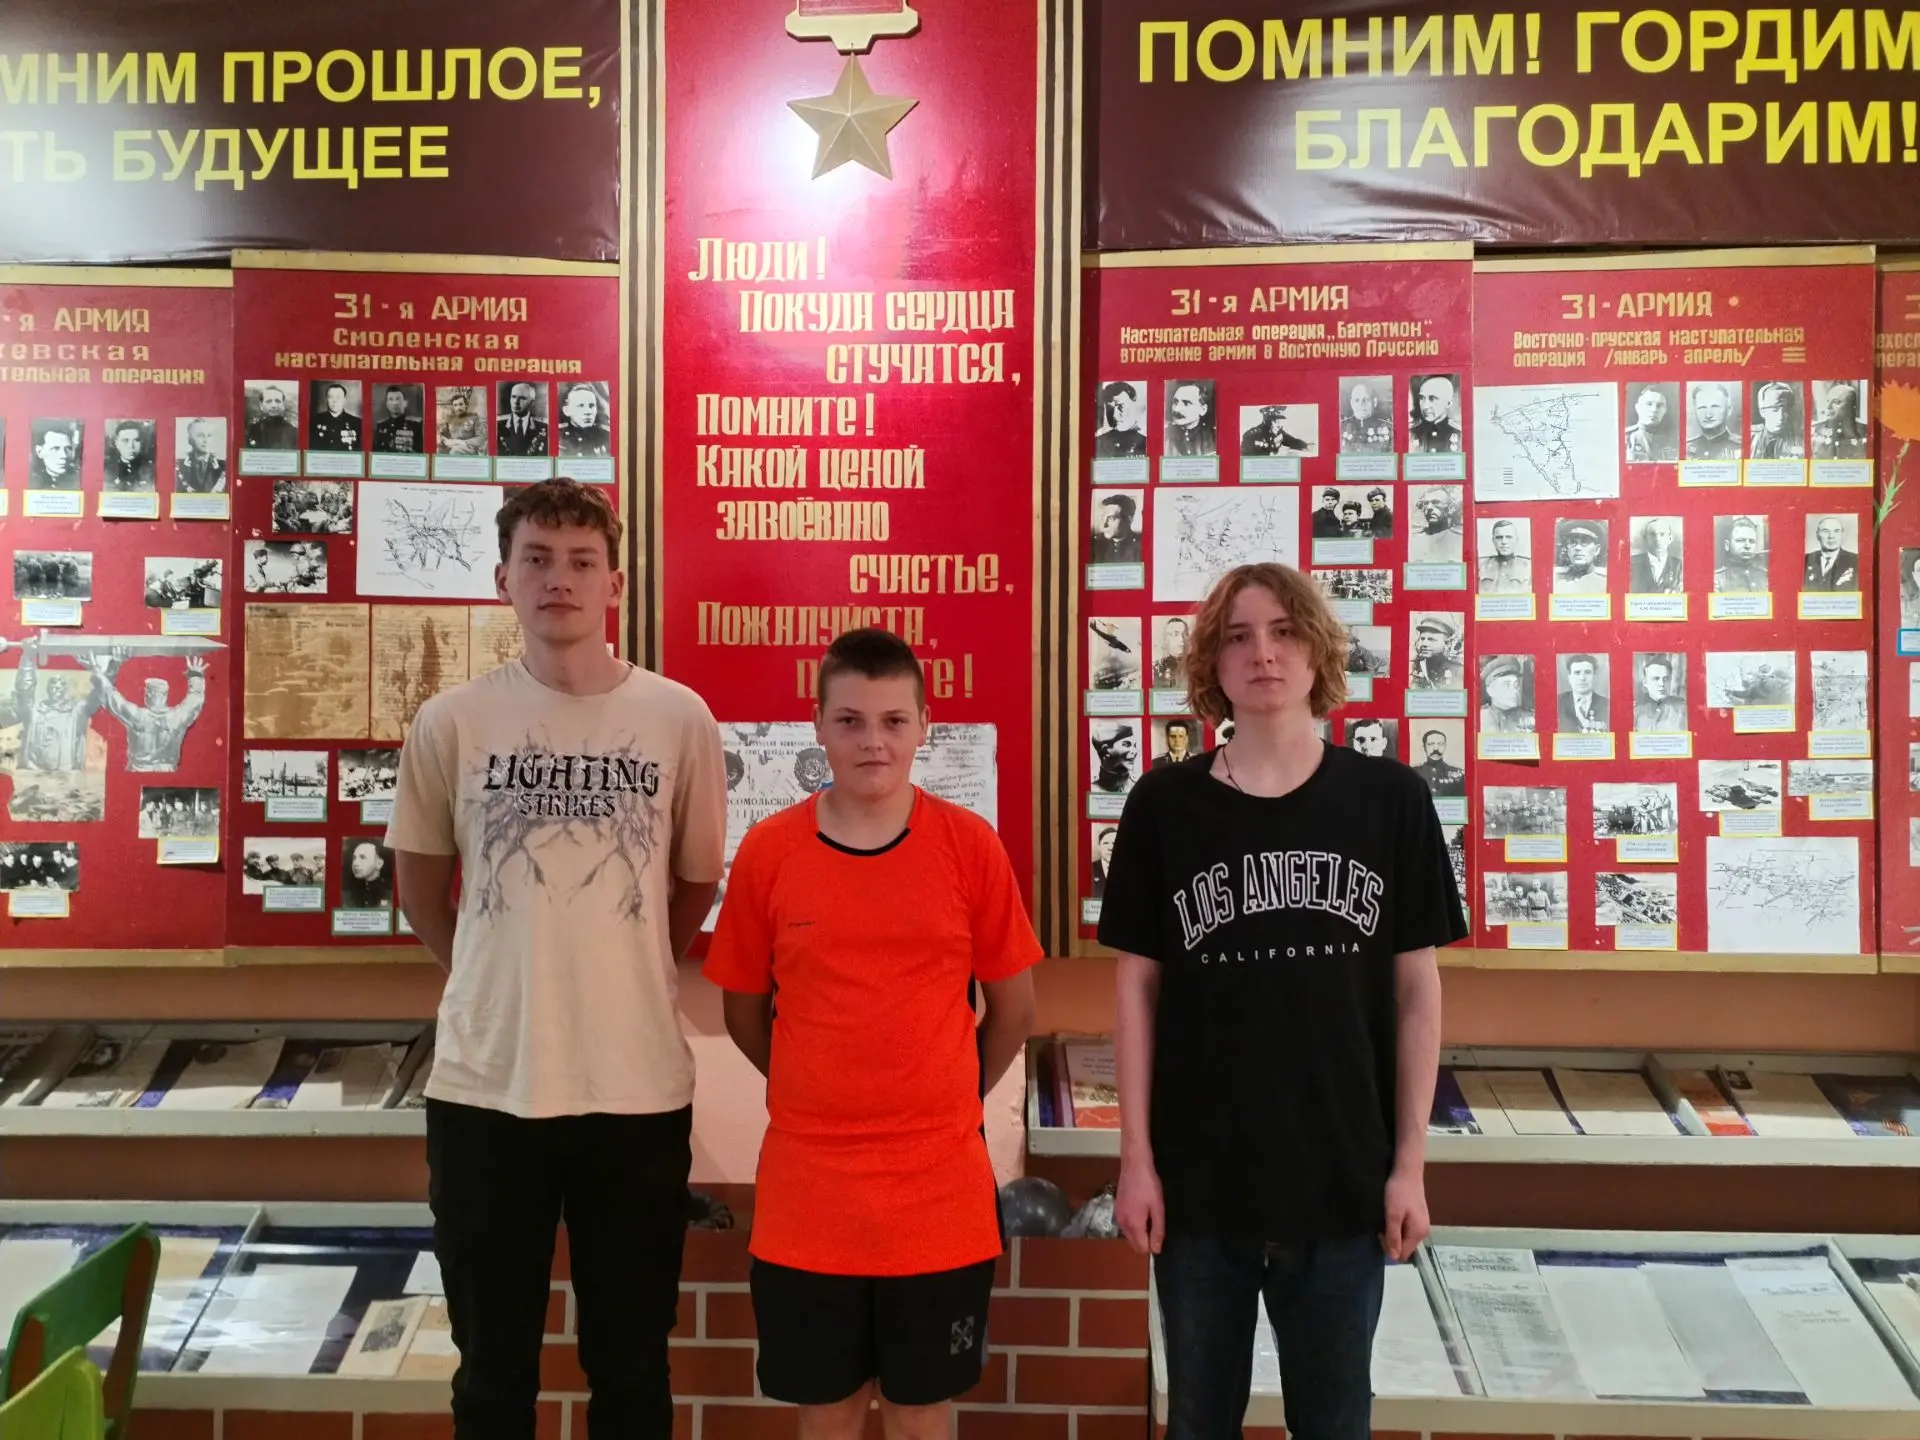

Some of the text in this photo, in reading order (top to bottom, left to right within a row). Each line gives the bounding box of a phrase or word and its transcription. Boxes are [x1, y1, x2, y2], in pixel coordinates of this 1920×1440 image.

[1139, 8, 1920, 84] ПОМНИМ! ГОРДИМ
[222, 47, 602, 108] ПРОШЛОЕ,
[1295, 101, 1918, 178] БЛАГОДАРИМ!
[0, 126, 450, 191] ТЬ БУДУЩЕЕ
[688, 236, 826, 282] Люди!
[431, 295, 528, 322] АРМИЯ
[739, 289, 1015, 334] Покуда сердца
[1249, 284, 1349, 313] АРМИЯ
[53, 307, 150, 333] АРМИЯ
[1120, 326, 1244, 345] Наступательная
[1252, 323, 1325, 341] операция
[1669, 327, 1804, 346] наступательная
[333, 327, 519, 350] Смоленская
[1120, 345, 1202, 364] вторжение
[1208, 344, 1257, 362] армии
[1278, 340, 1361, 360] Восточную
[1366, 338, 1439, 358] Пруссию
[102, 367, 205, 385] операция
[275, 352, 582, 374] наступательная операция
[826, 342, 1021, 386] стучатся,
[1513, 350, 1586, 368] операция
[696, 393, 875, 437] Помните!
[696, 444, 926, 491] Какой ценой
[849, 553, 1014, 595] счастье,
[483, 753, 660, 797] LIGHTING
[519, 793, 616, 818] STRIKES
[1173, 850, 1384, 950] LOS ANGELES
[1201, 942, 1360, 964] CALIFORNIA
